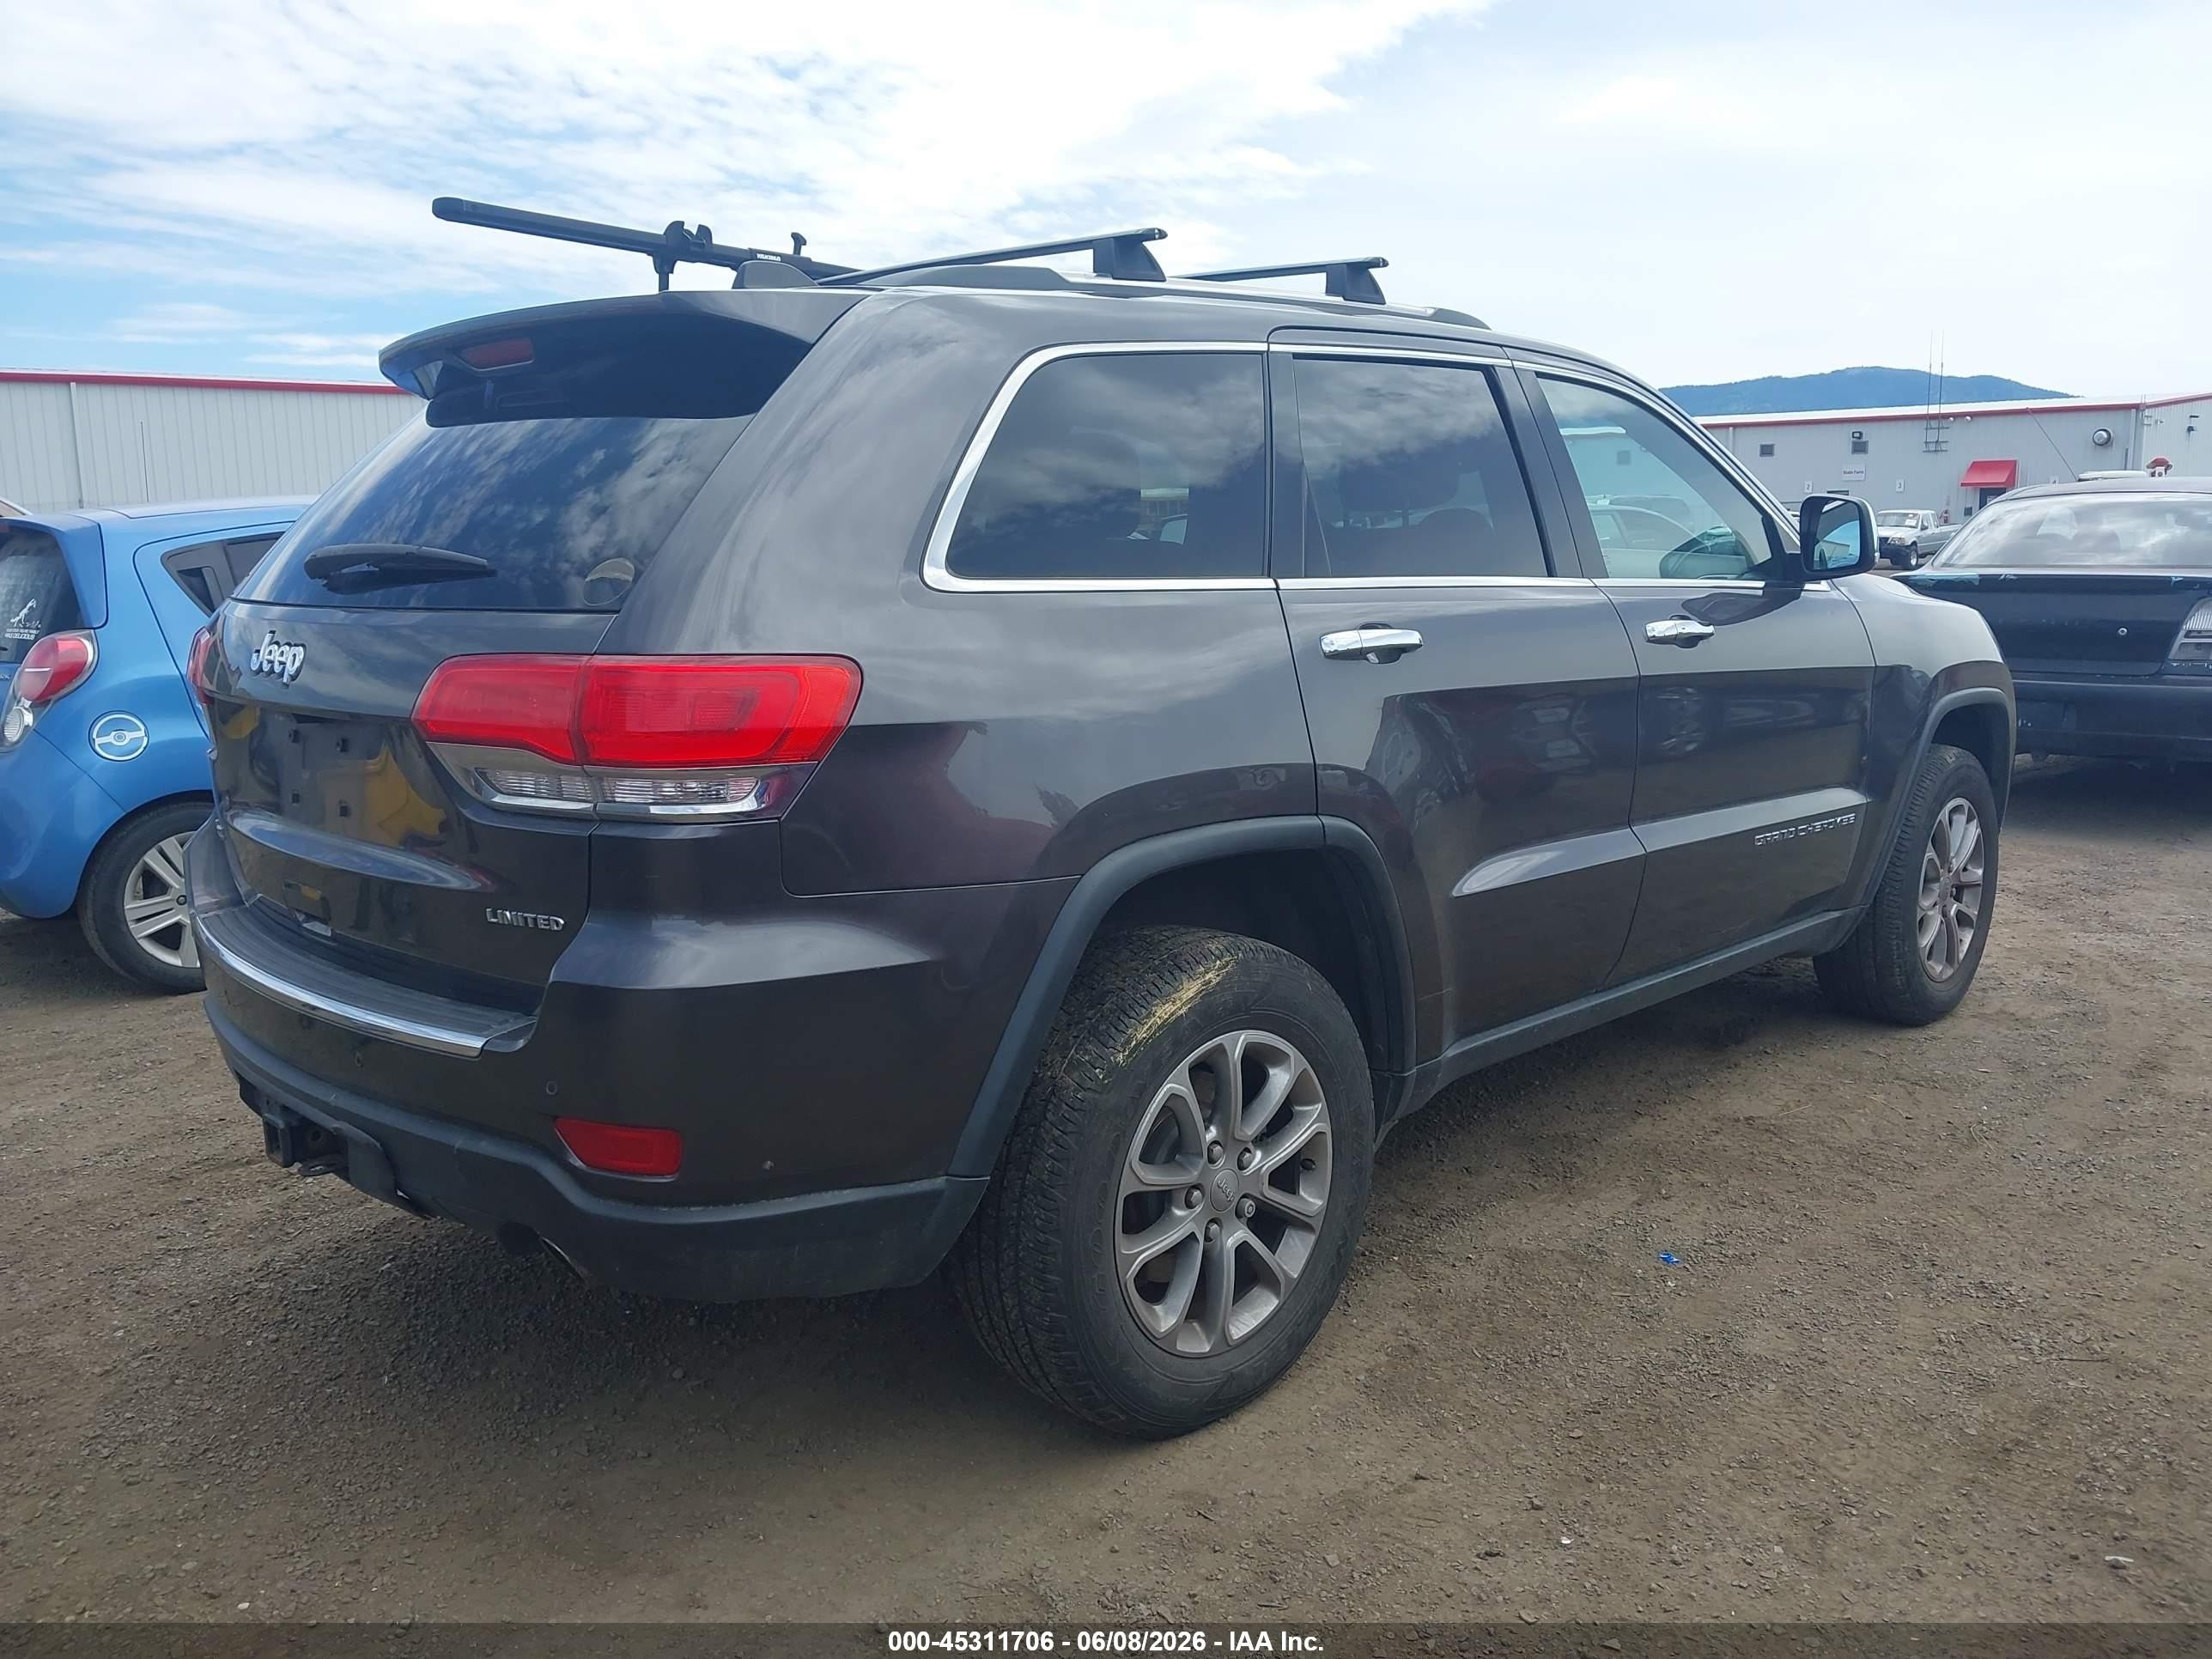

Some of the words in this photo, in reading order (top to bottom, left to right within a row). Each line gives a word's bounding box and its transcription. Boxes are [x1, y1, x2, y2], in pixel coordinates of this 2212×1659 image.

[250, 631, 306, 687] Jeep
[1755, 827, 1796, 845] GRAND
[1797, 813, 1856, 836] CHEROKEE
[485, 908, 565, 932] LIMITED
[1217, 1178, 1234, 1202] Jeep
